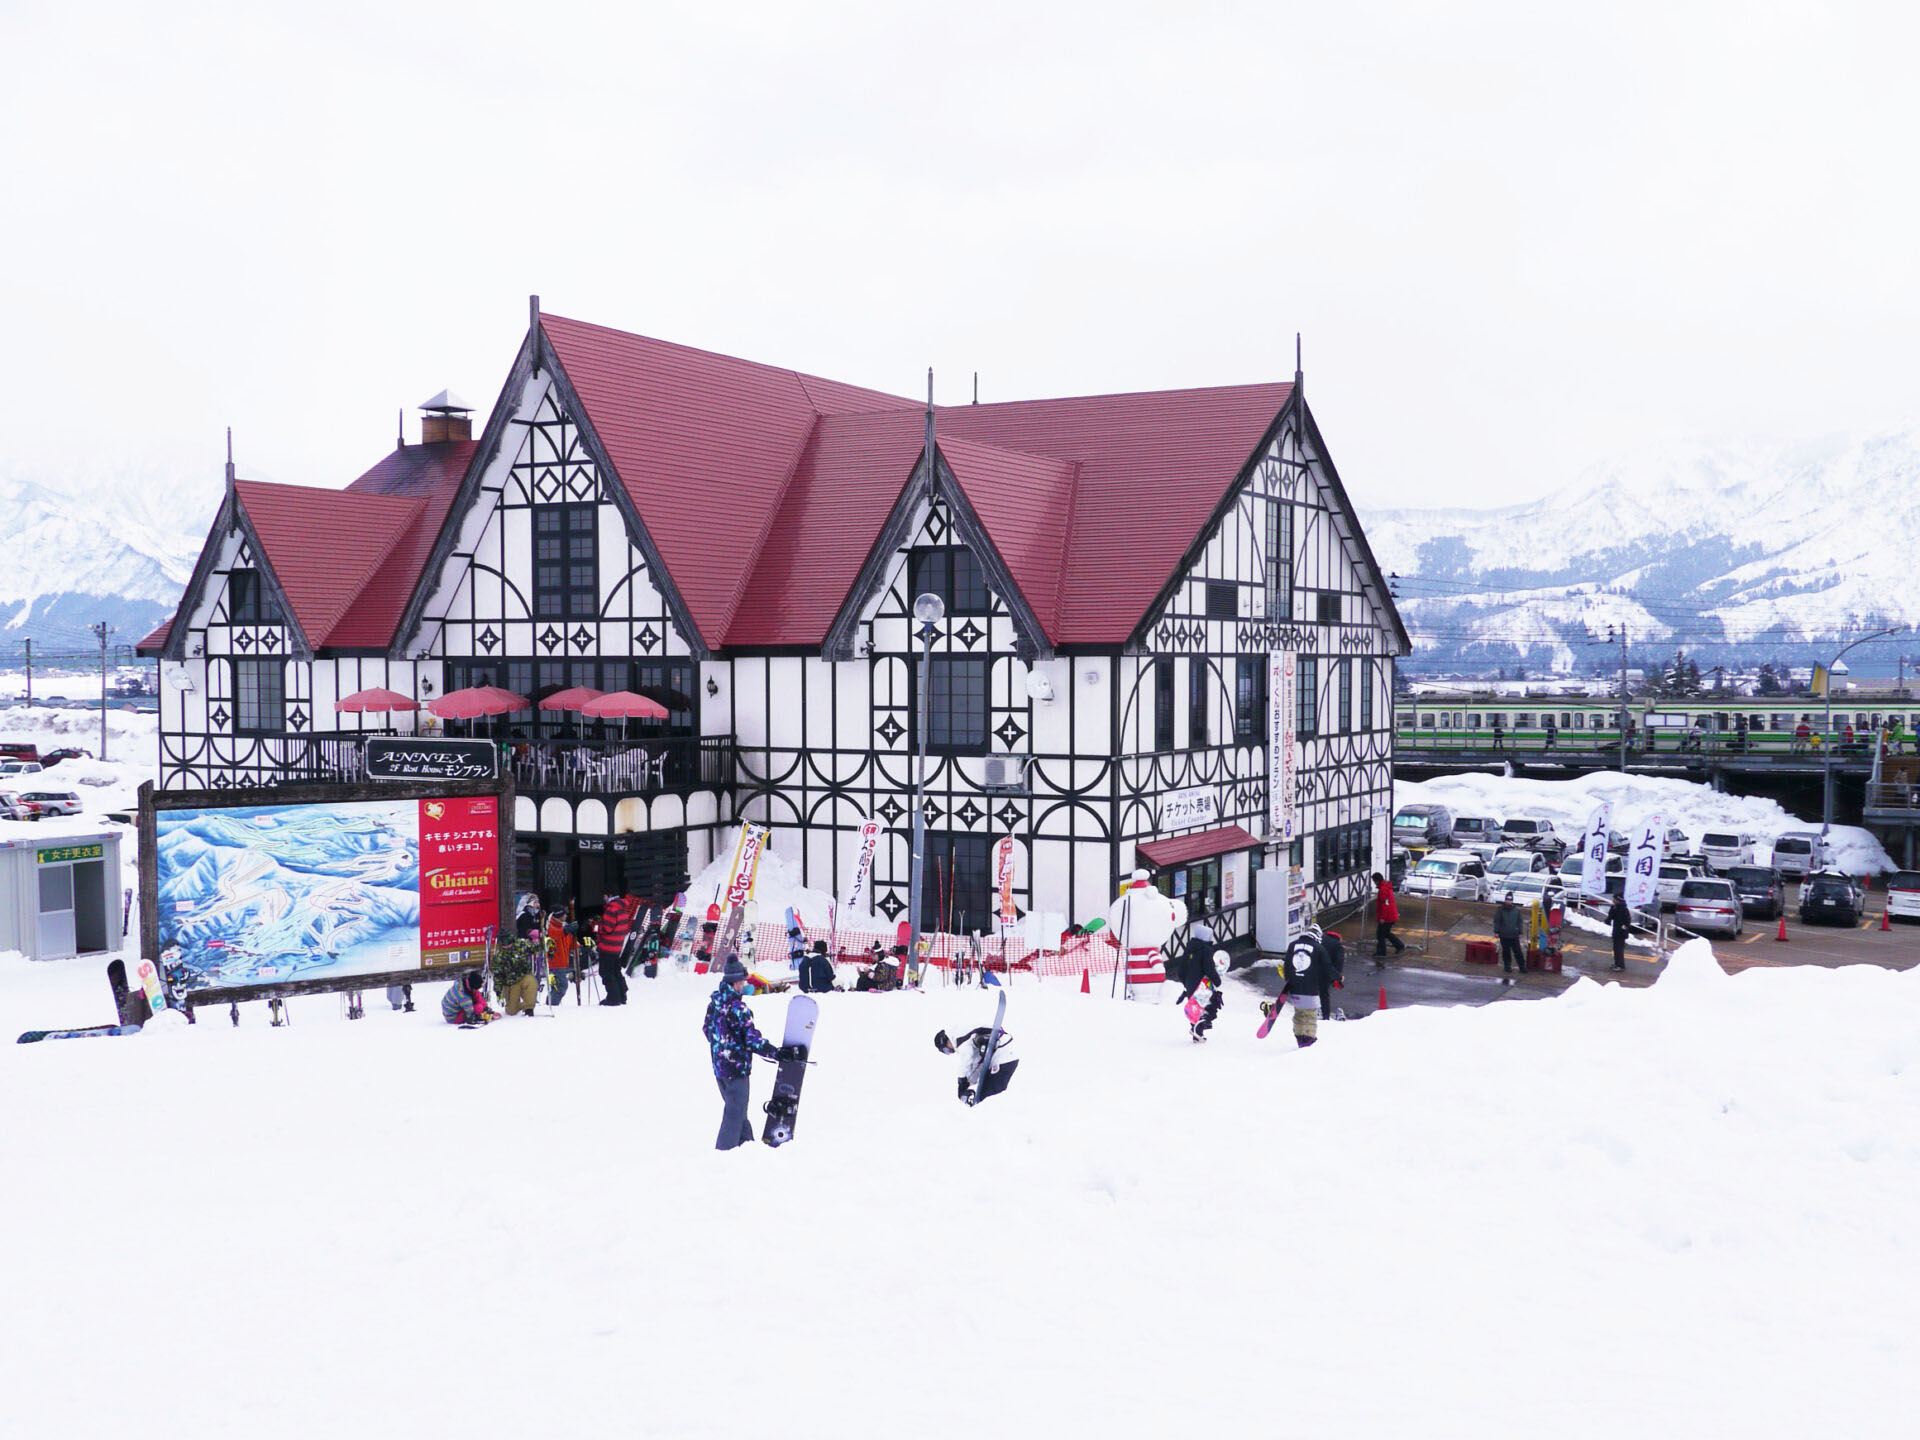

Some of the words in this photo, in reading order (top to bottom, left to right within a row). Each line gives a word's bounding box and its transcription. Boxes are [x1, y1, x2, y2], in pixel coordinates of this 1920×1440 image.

[375, 751, 472, 764] ANNEX
[1591, 817, 1606, 863] 上国
[1635, 828, 1656, 877] 上国
[430, 874, 488, 889] Ghana
